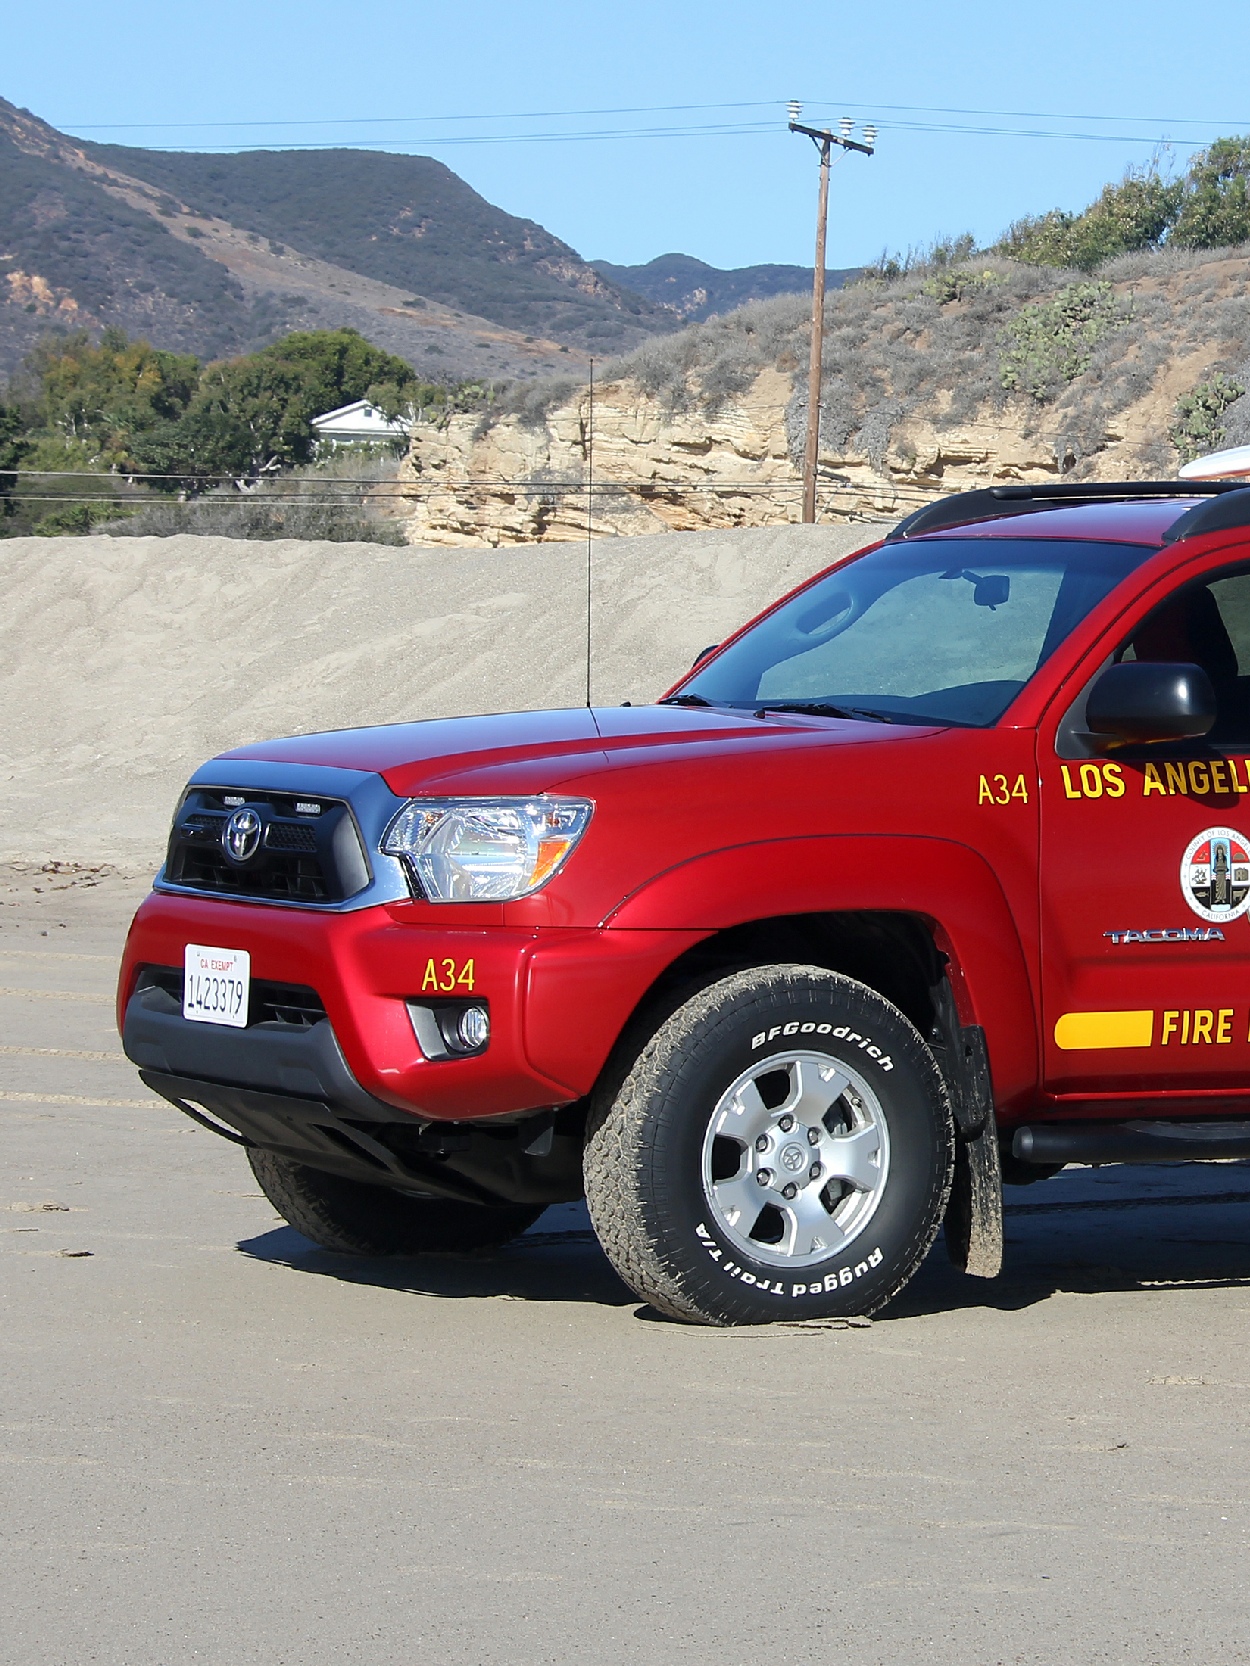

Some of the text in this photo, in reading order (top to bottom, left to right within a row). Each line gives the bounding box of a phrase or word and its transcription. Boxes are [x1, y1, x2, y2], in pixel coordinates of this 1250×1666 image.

[978, 774, 1029, 805] A34
[1061, 763, 1125, 799] LOS
[1186, 836, 1205, 859] COUNTY
[1217, 829, 1230, 837] LOS
[1201, 910, 1240, 921] CALIFORNIA
[1102, 927, 1226, 944] TACOMA
[200, 958, 234, 972] CA EXEMPT
[421, 958, 475, 991] A34
[187, 974, 243, 1015] 1423379
[1161, 1008, 1234, 1046] FIRE
[751, 1021, 894, 1072] BFGoodrich
[695, 1223, 884, 1298] Rugged Trail T/A
